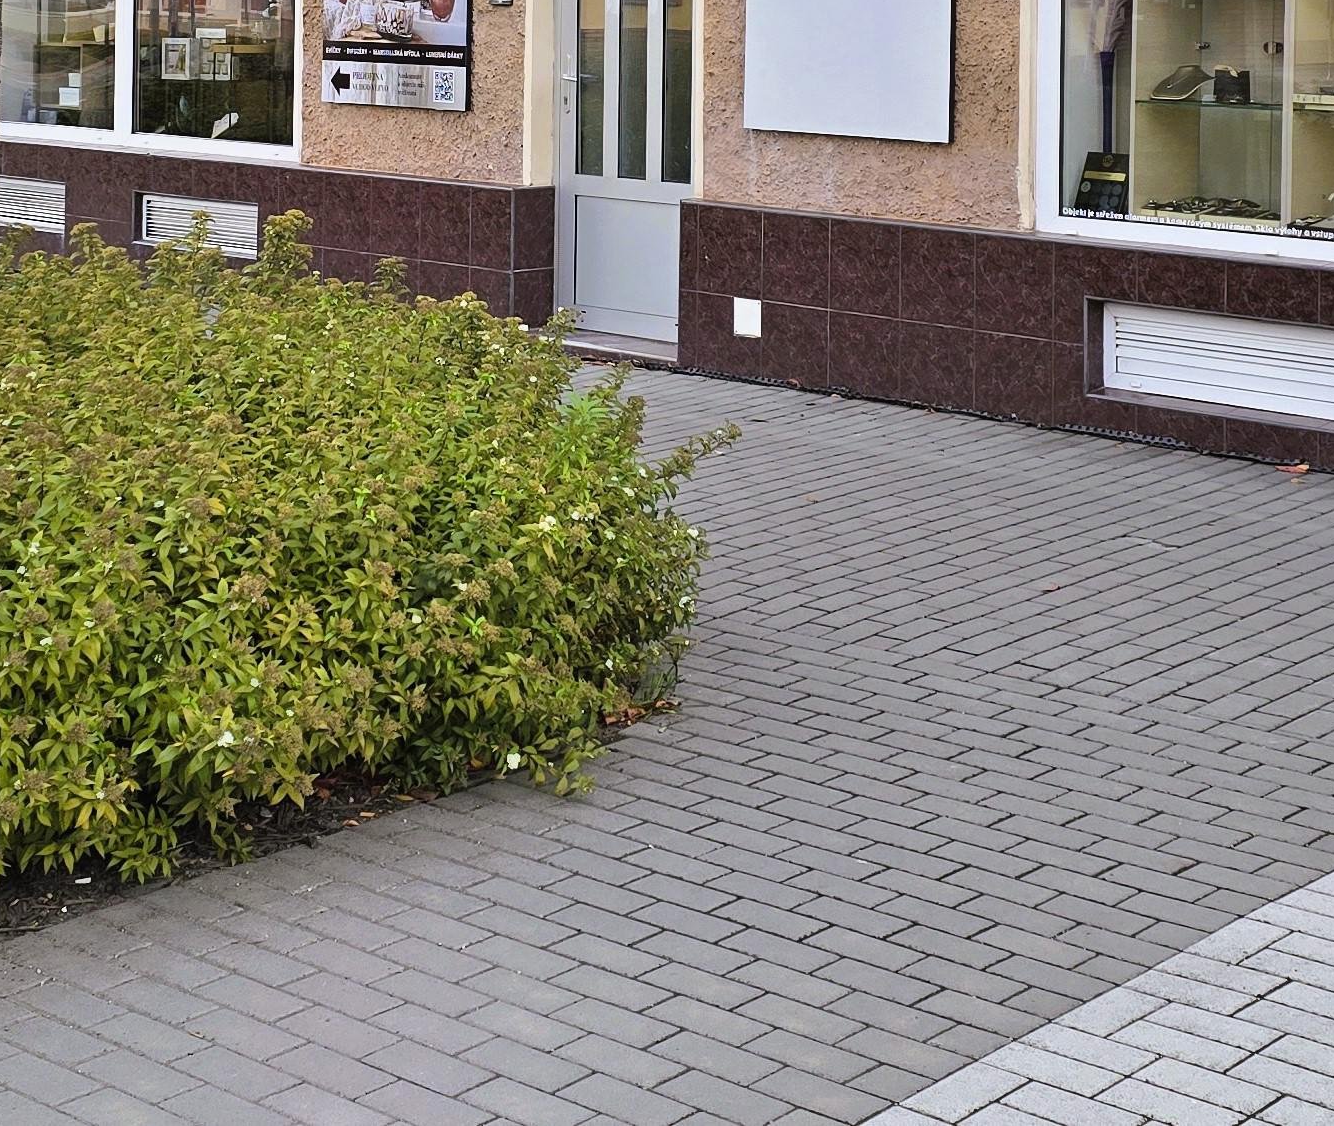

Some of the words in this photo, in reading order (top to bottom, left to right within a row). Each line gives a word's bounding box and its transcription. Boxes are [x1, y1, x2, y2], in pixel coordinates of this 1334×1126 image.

[1062, 206, 1087, 217] Objekt
[1087, 209, 1095, 218] je
[1095, 209, 1124, 221] střežen
